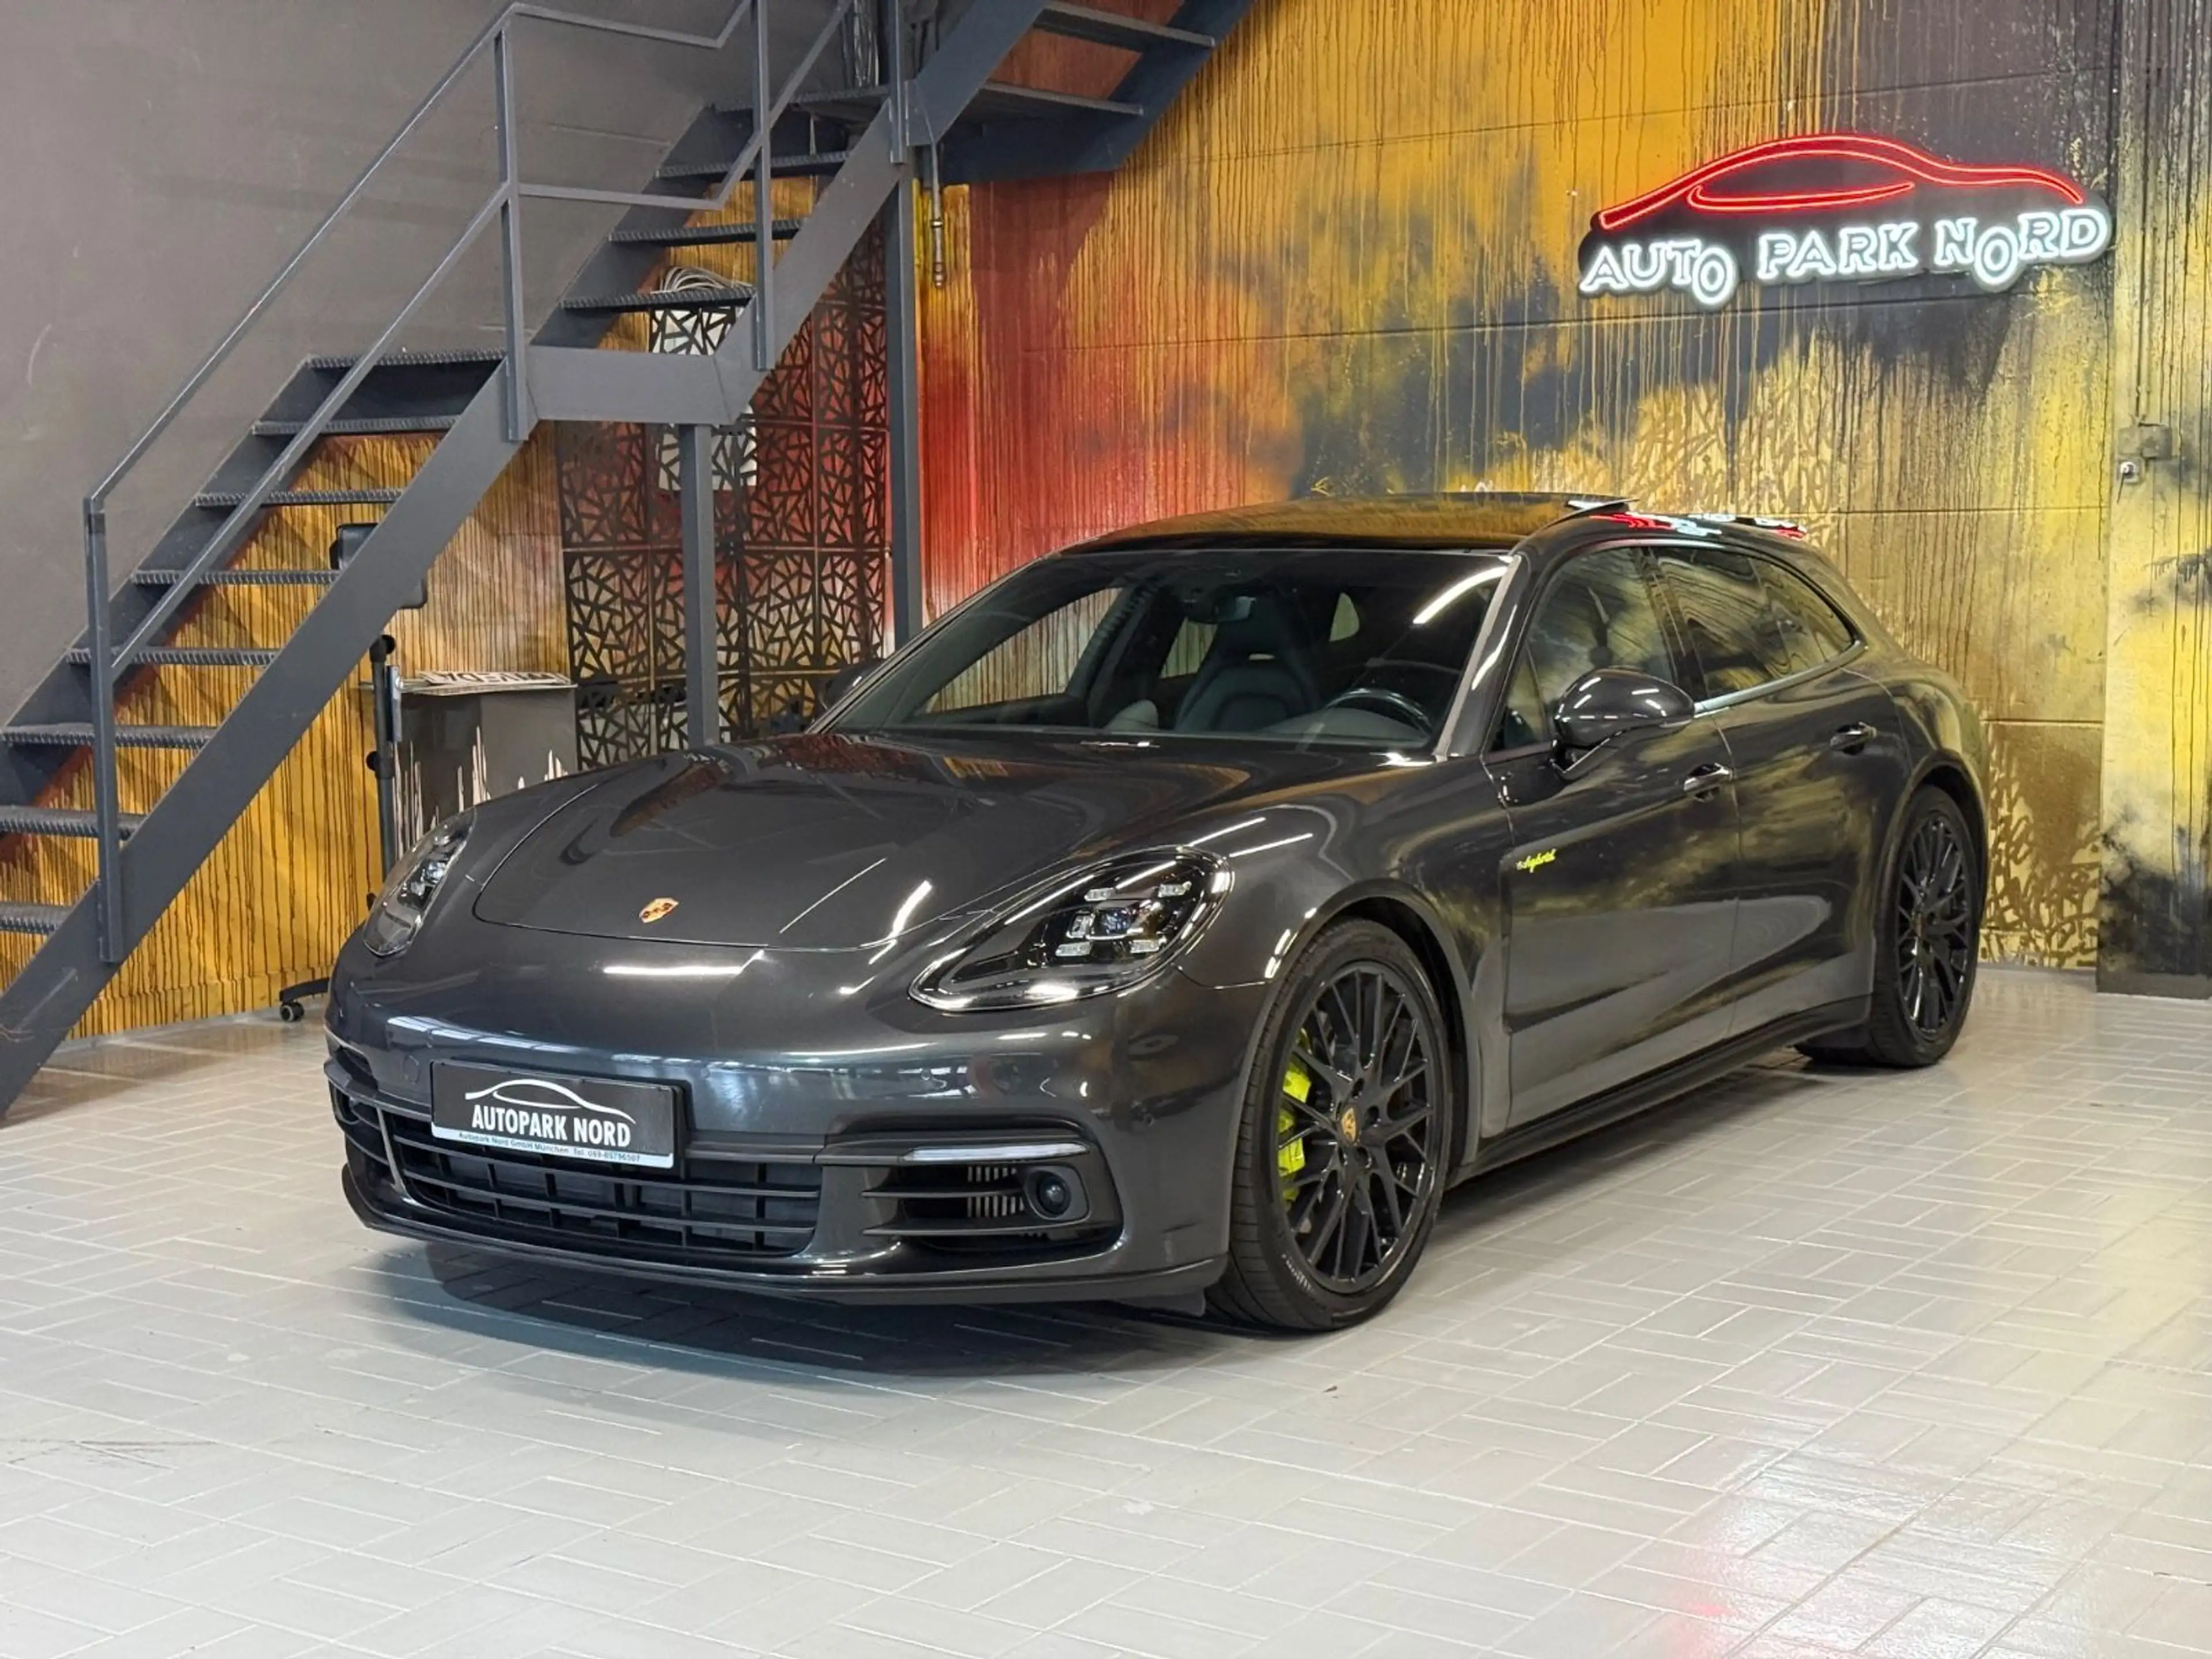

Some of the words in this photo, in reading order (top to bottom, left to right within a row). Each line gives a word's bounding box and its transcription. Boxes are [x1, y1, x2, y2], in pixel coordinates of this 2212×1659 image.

[1579, 238, 1736, 305] AUTO
[1757, 221, 1919, 279] PARK
[1933, 208, 2109, 285] NORD
[472, 1104, 568, 1141] AUTOPARK
[573, 1117, 631, 1147] NORD
